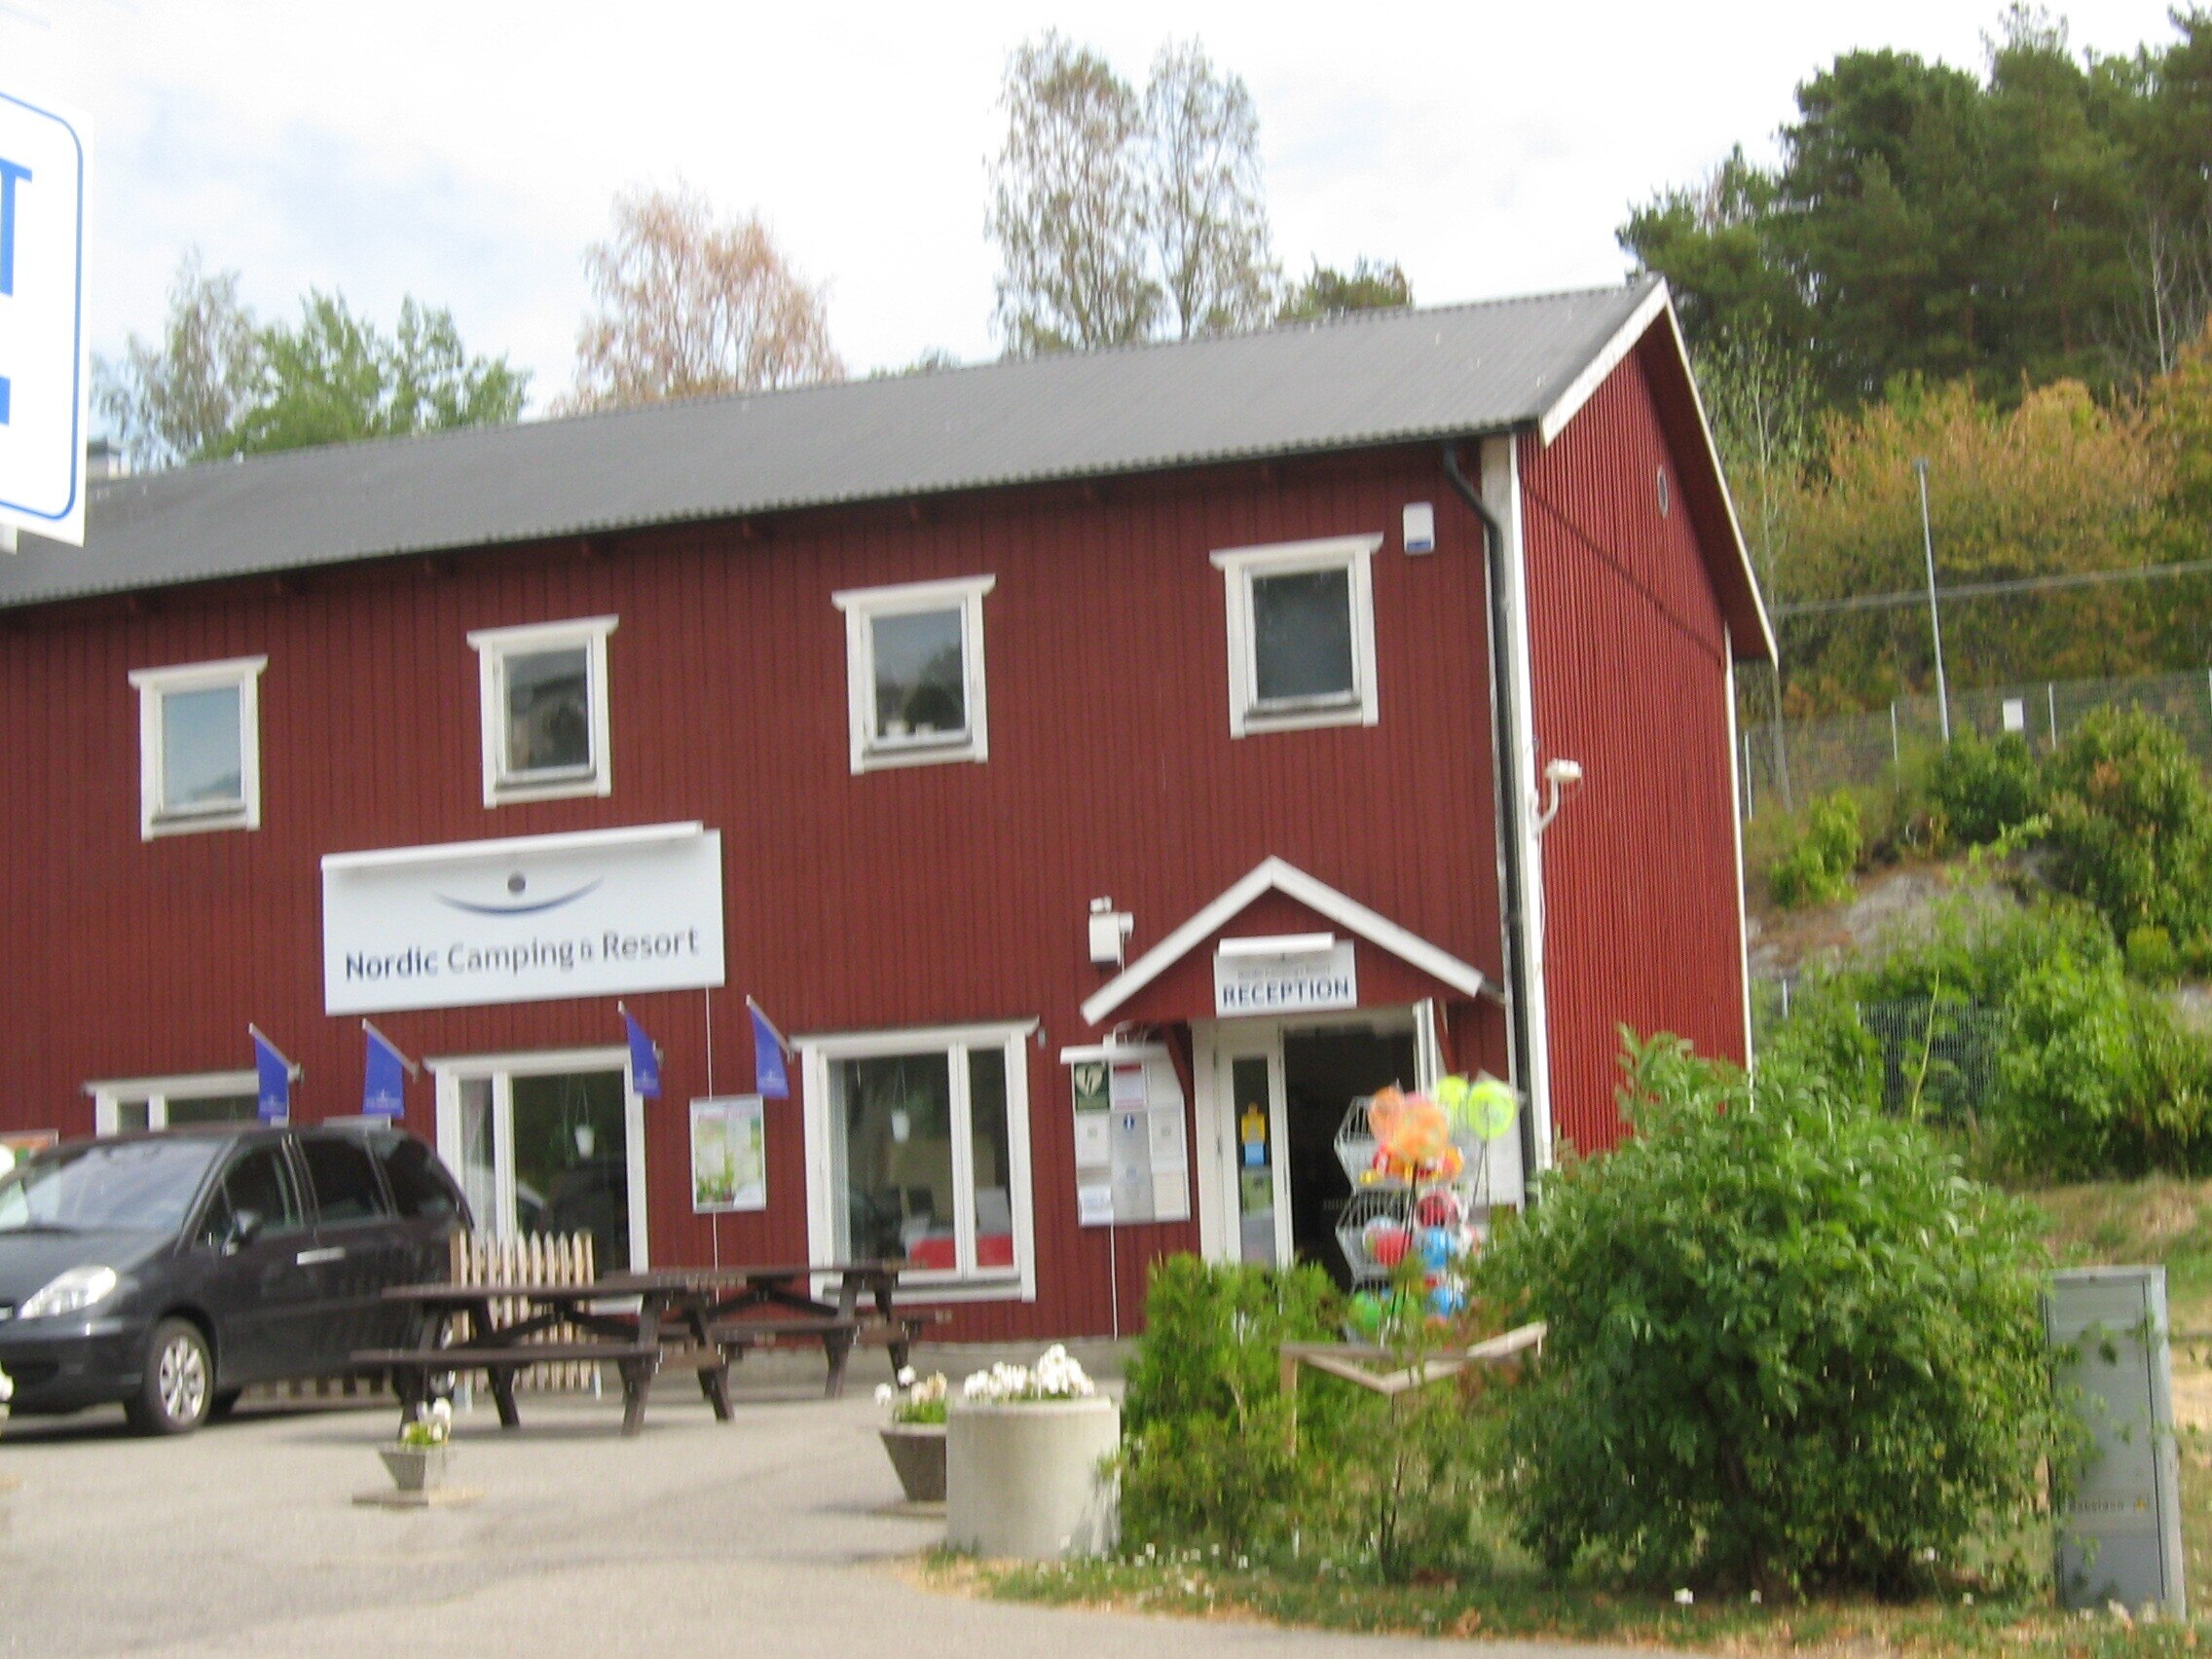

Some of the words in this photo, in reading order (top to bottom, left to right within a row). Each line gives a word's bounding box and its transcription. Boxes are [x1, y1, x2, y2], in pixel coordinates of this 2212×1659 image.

[346, 941, 438, 981] Nordic
[448, 935, 573, 977] Camping
[603, 925, 699, 962] Resort
[1223, 976, 1349, 1008] RECEPTION
